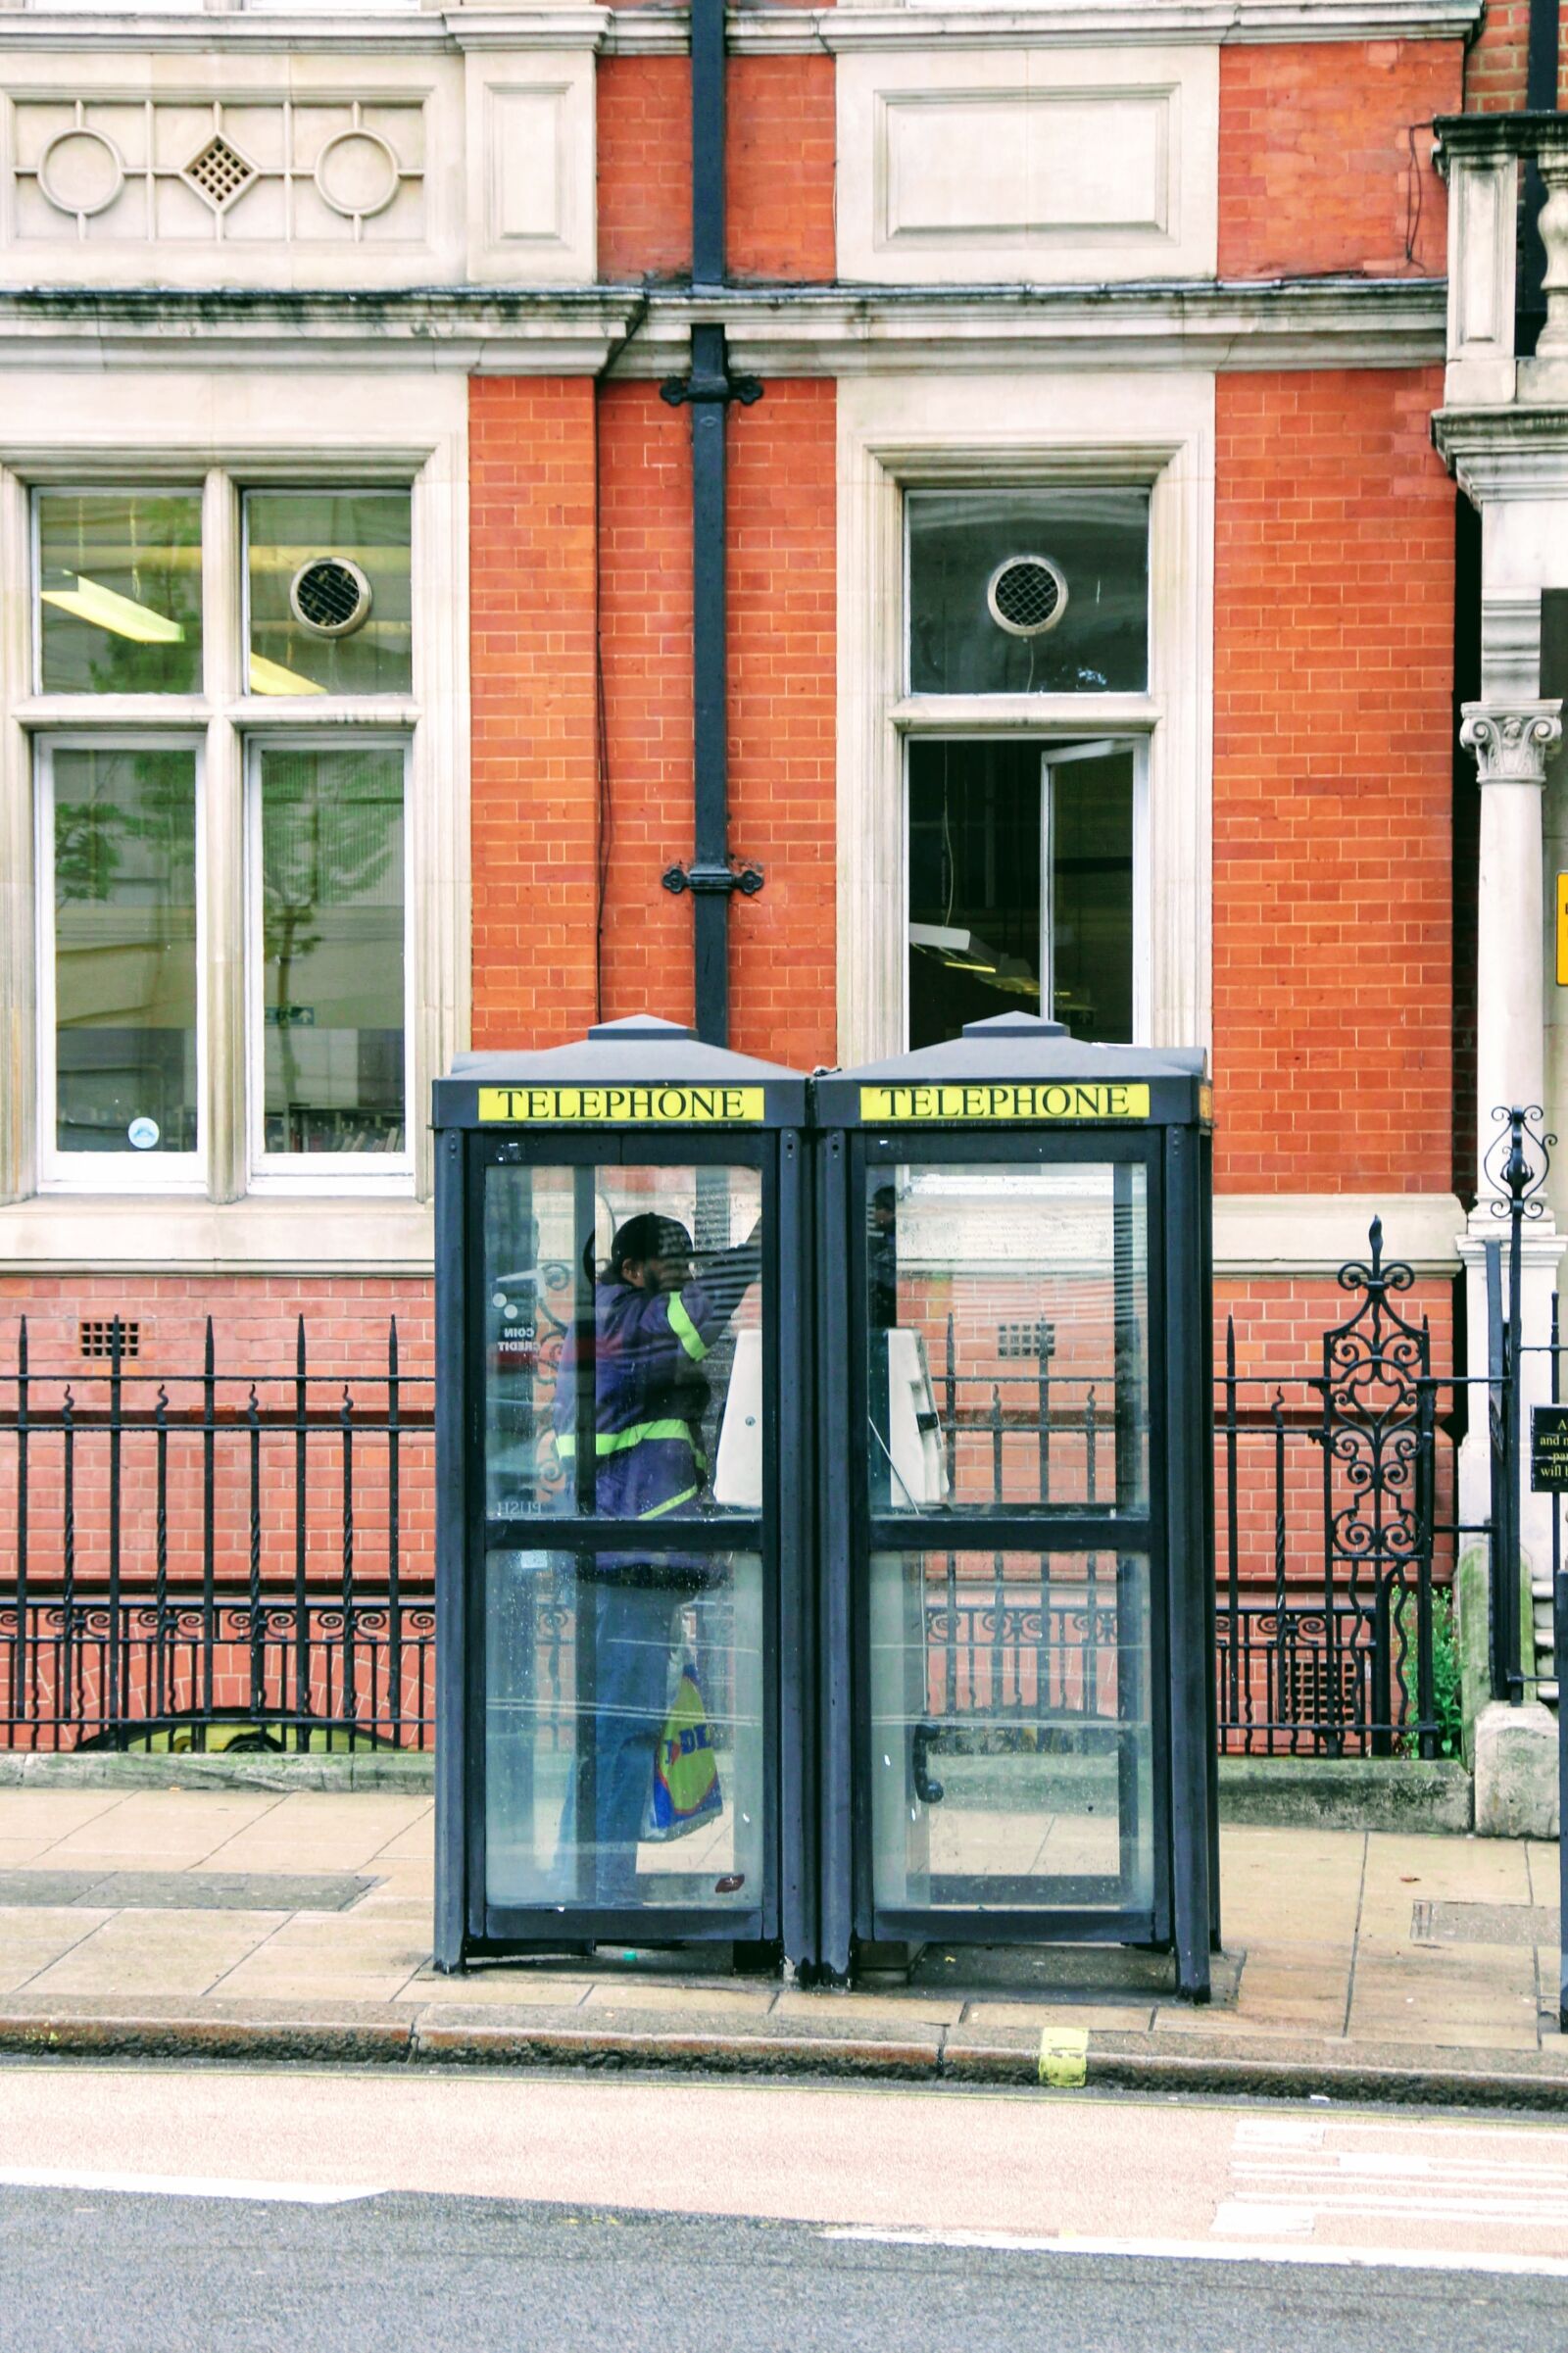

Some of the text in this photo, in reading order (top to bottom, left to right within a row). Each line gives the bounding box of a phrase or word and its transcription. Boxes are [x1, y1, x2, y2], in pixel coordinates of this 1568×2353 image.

[498, 1090, 745, 1118] TELEPHONE
[880, 1086, 1130, 1116] TELEPHONE
[1540, 1435, 1559, 1446] and
